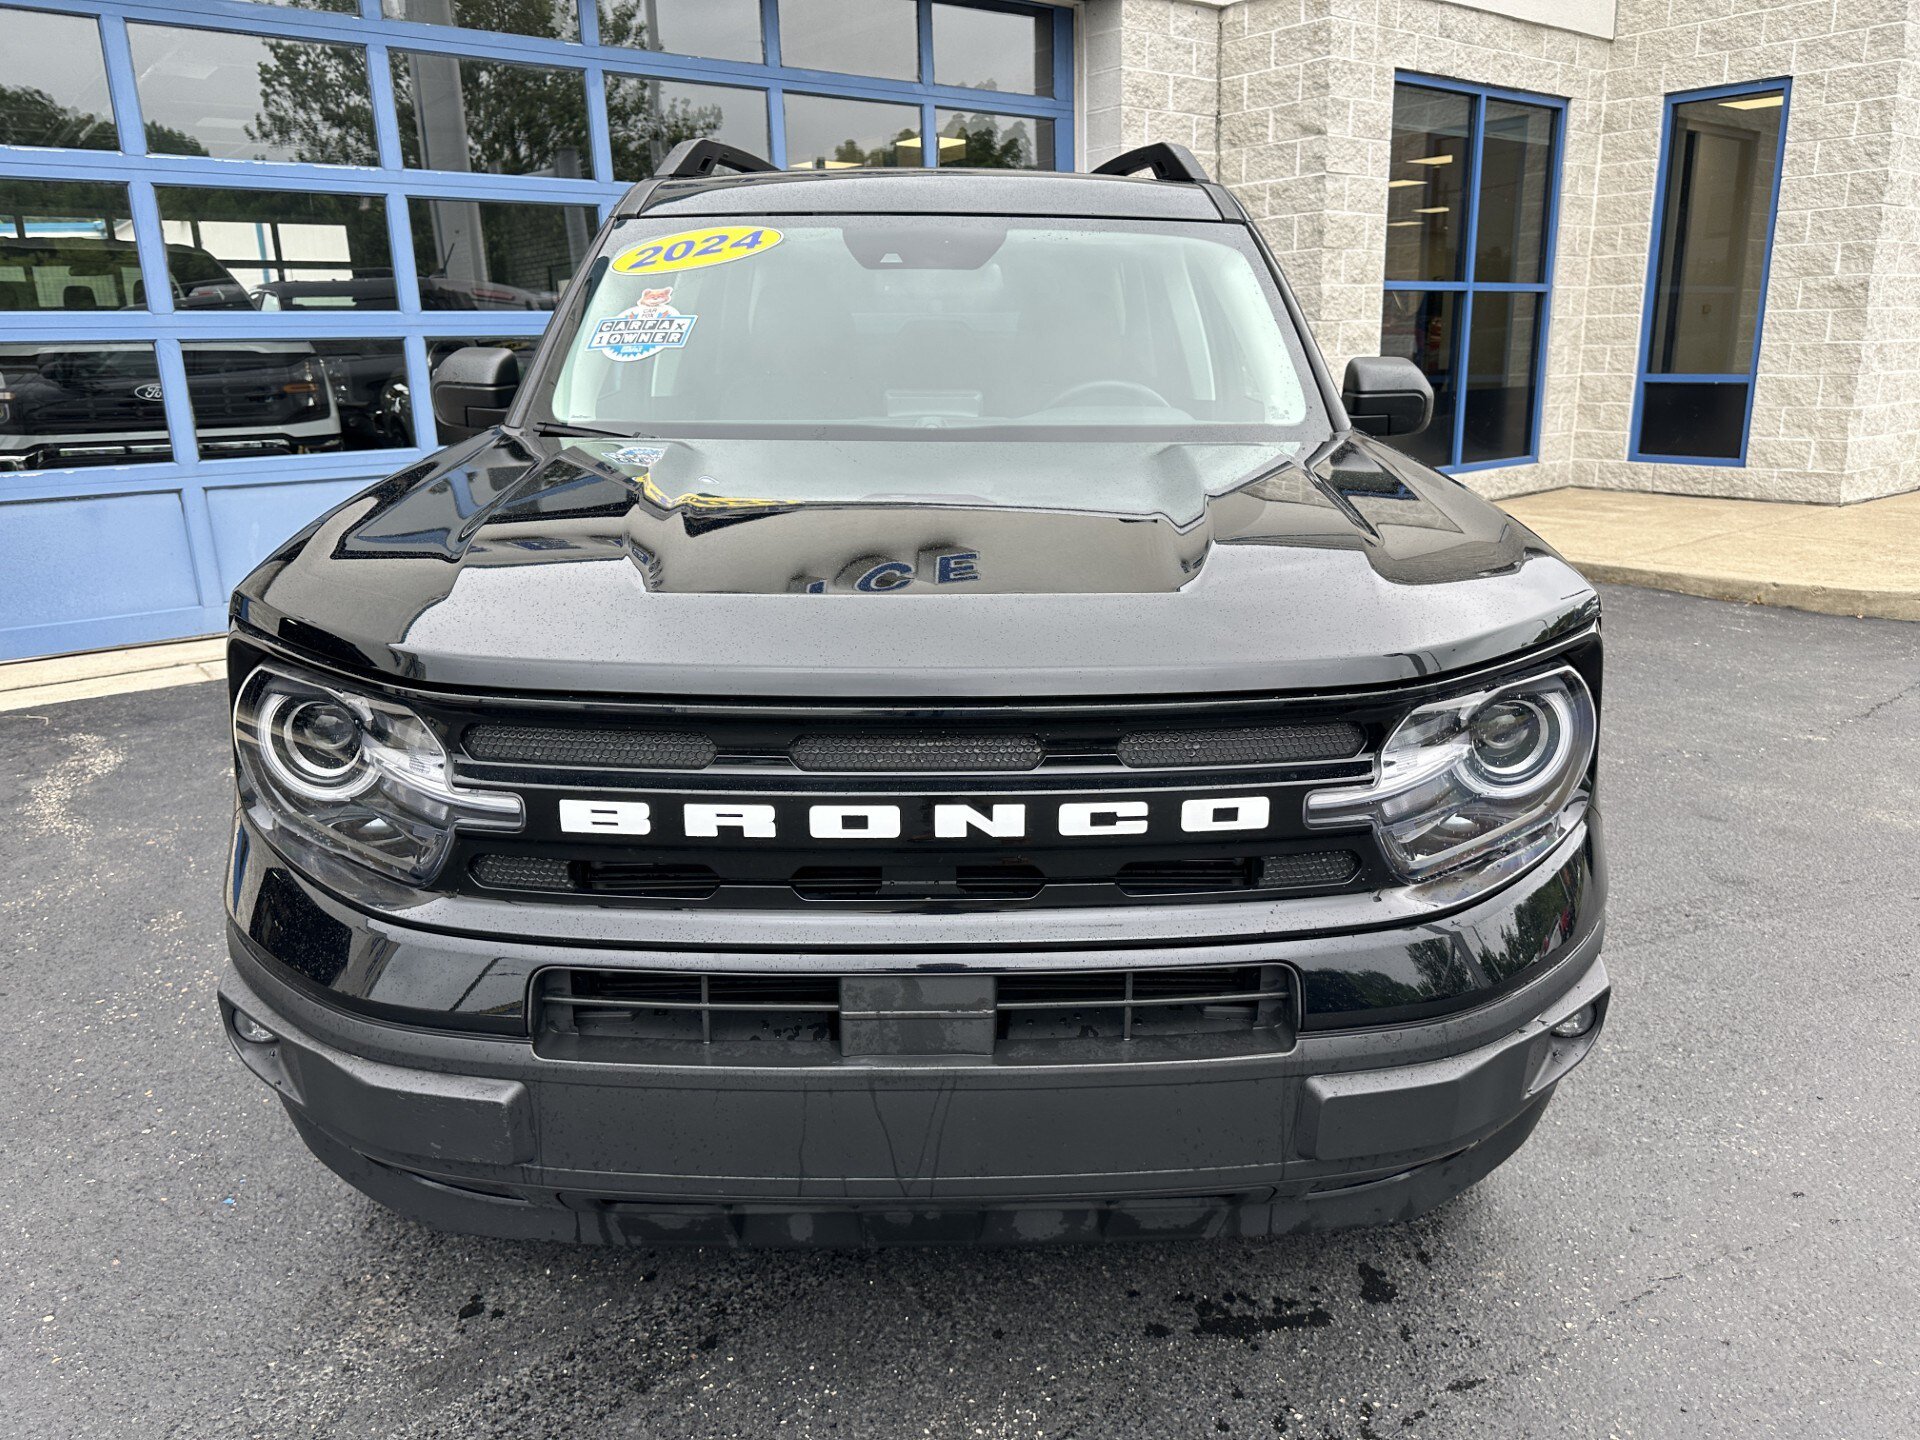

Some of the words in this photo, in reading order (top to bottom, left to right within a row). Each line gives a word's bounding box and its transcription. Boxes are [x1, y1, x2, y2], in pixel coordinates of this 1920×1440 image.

[627, 230, 765, 270] 2024
[600, 319, 686, 332] CARFAX
[608, 331, 683, 344] OWNER
[559, 796, 1270, 838] BRONCO
